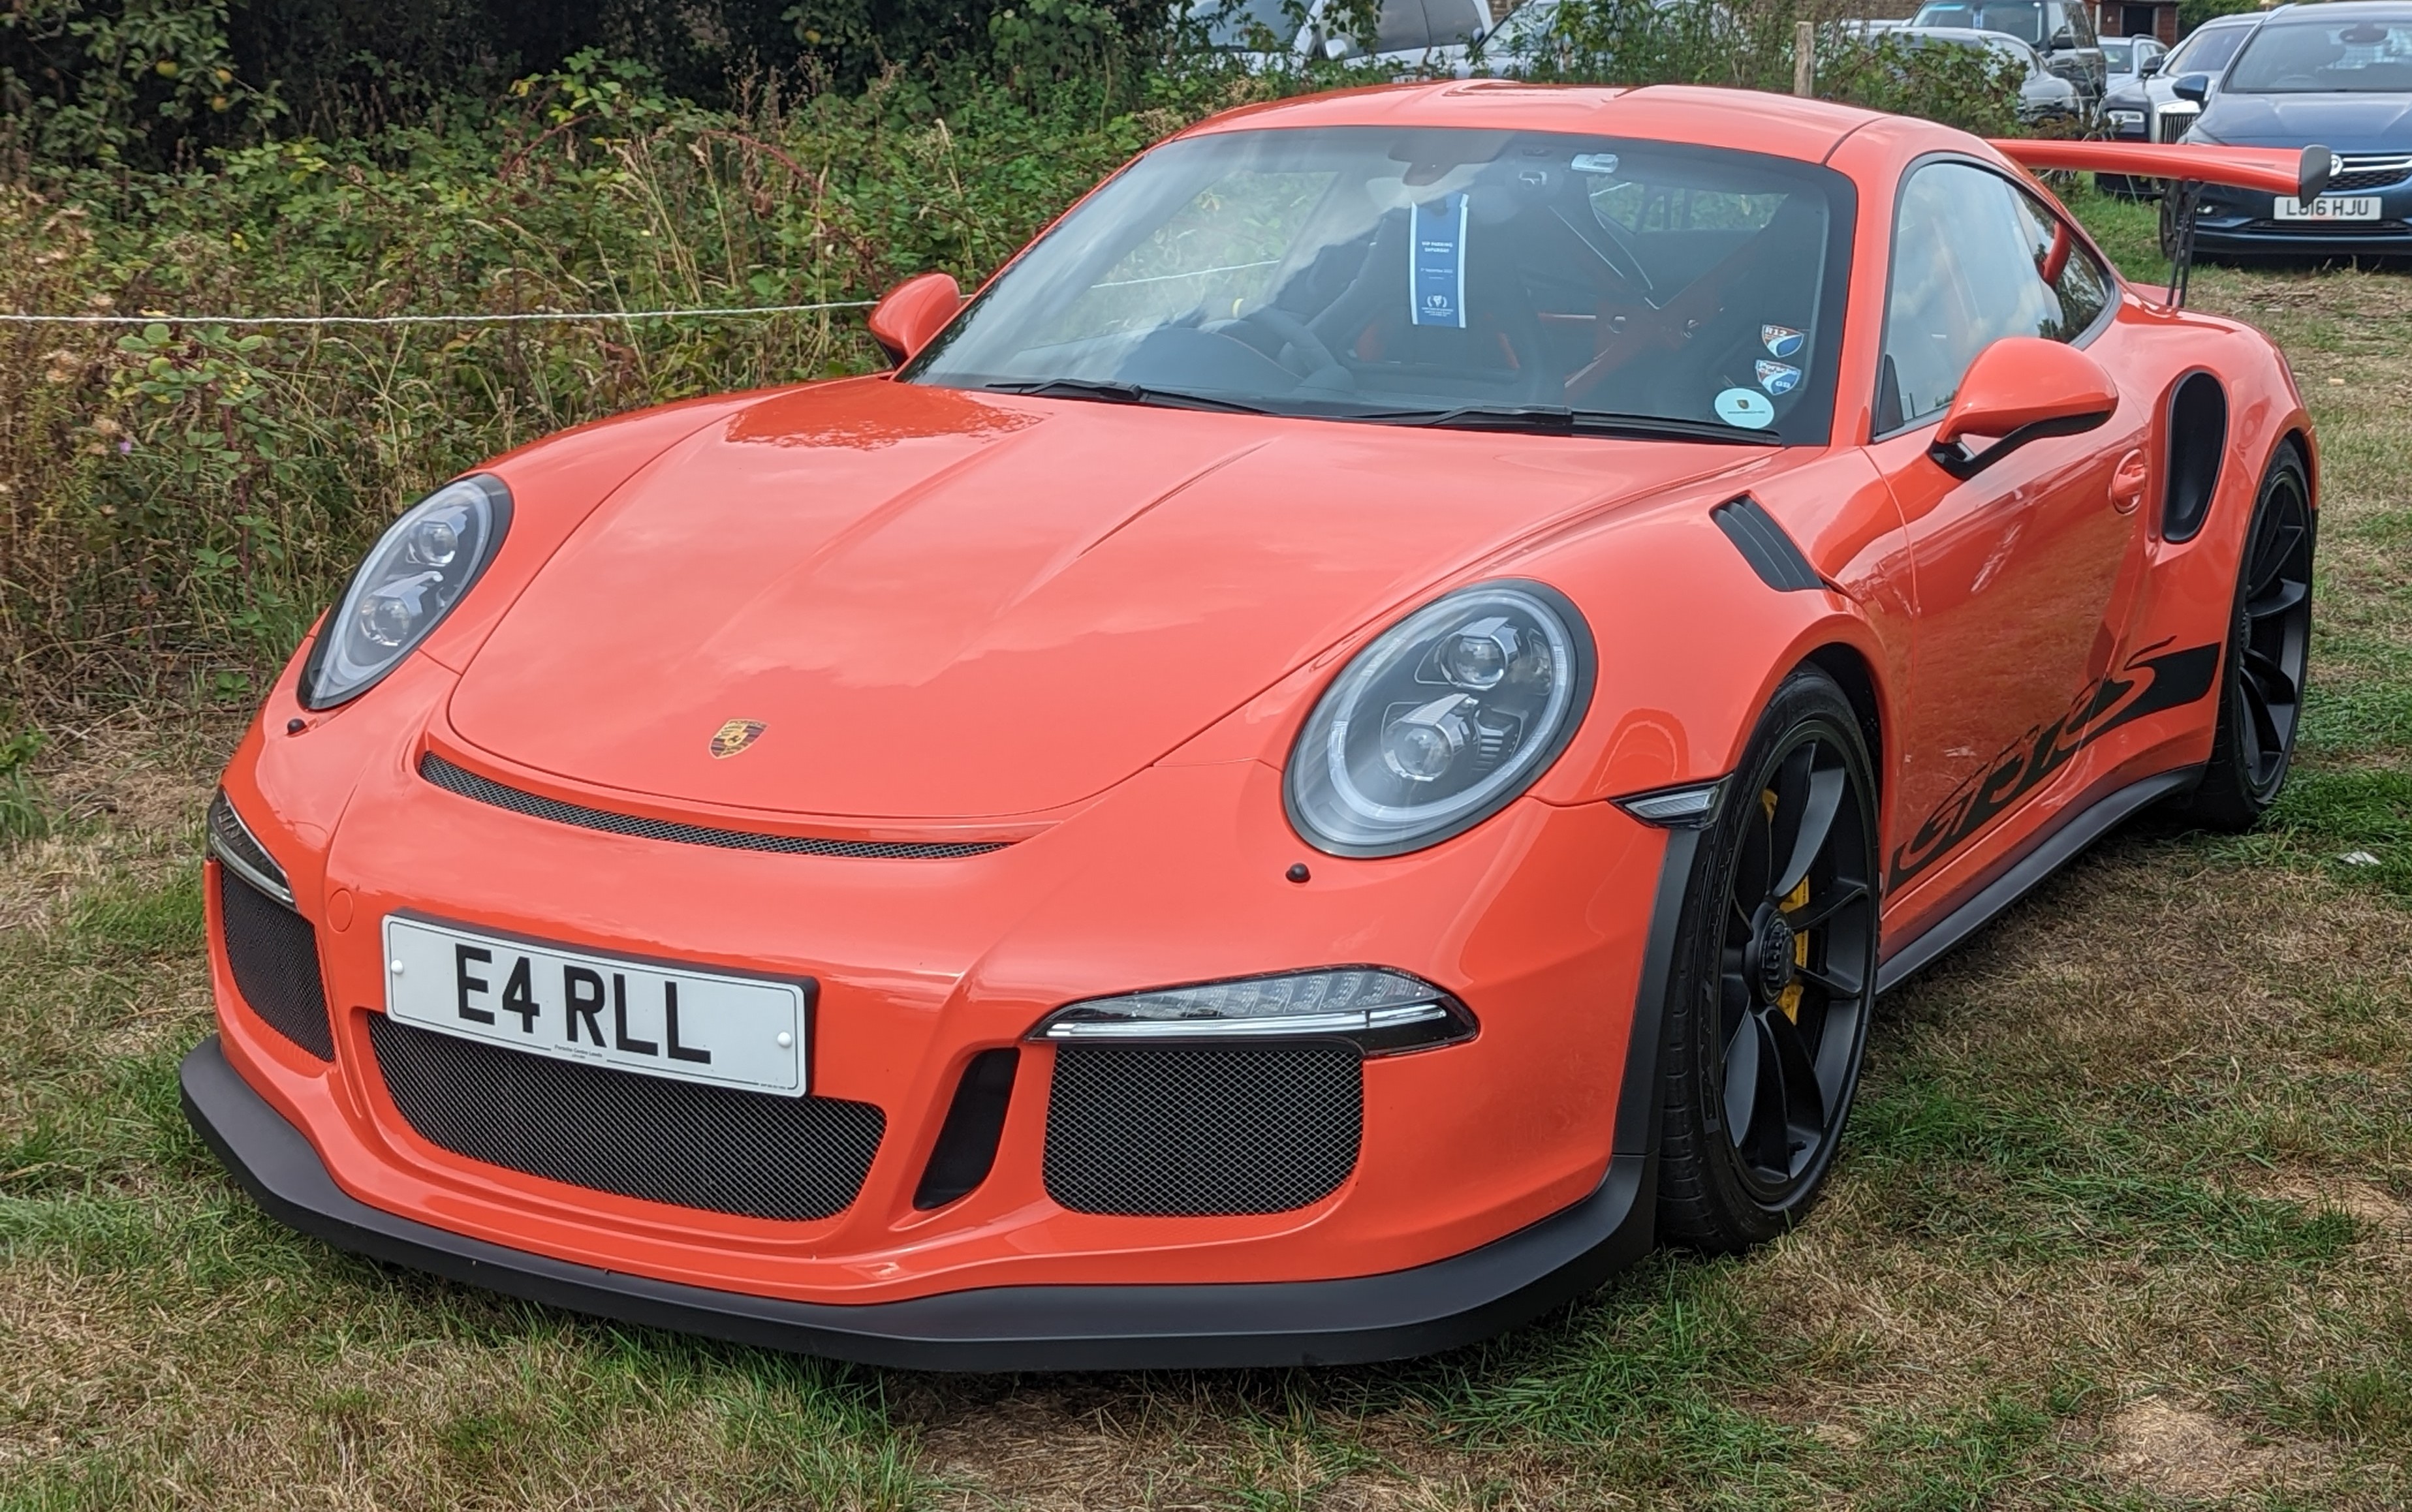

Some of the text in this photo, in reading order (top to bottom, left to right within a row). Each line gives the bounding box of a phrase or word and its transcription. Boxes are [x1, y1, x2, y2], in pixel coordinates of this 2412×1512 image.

[2332, 199, 2369, 216] HJU
[1765, 326, 1787, 336] R12
[1759, 361, 1798, 376] Porsche
[455, 943, 712, 1065] E4 RLL
